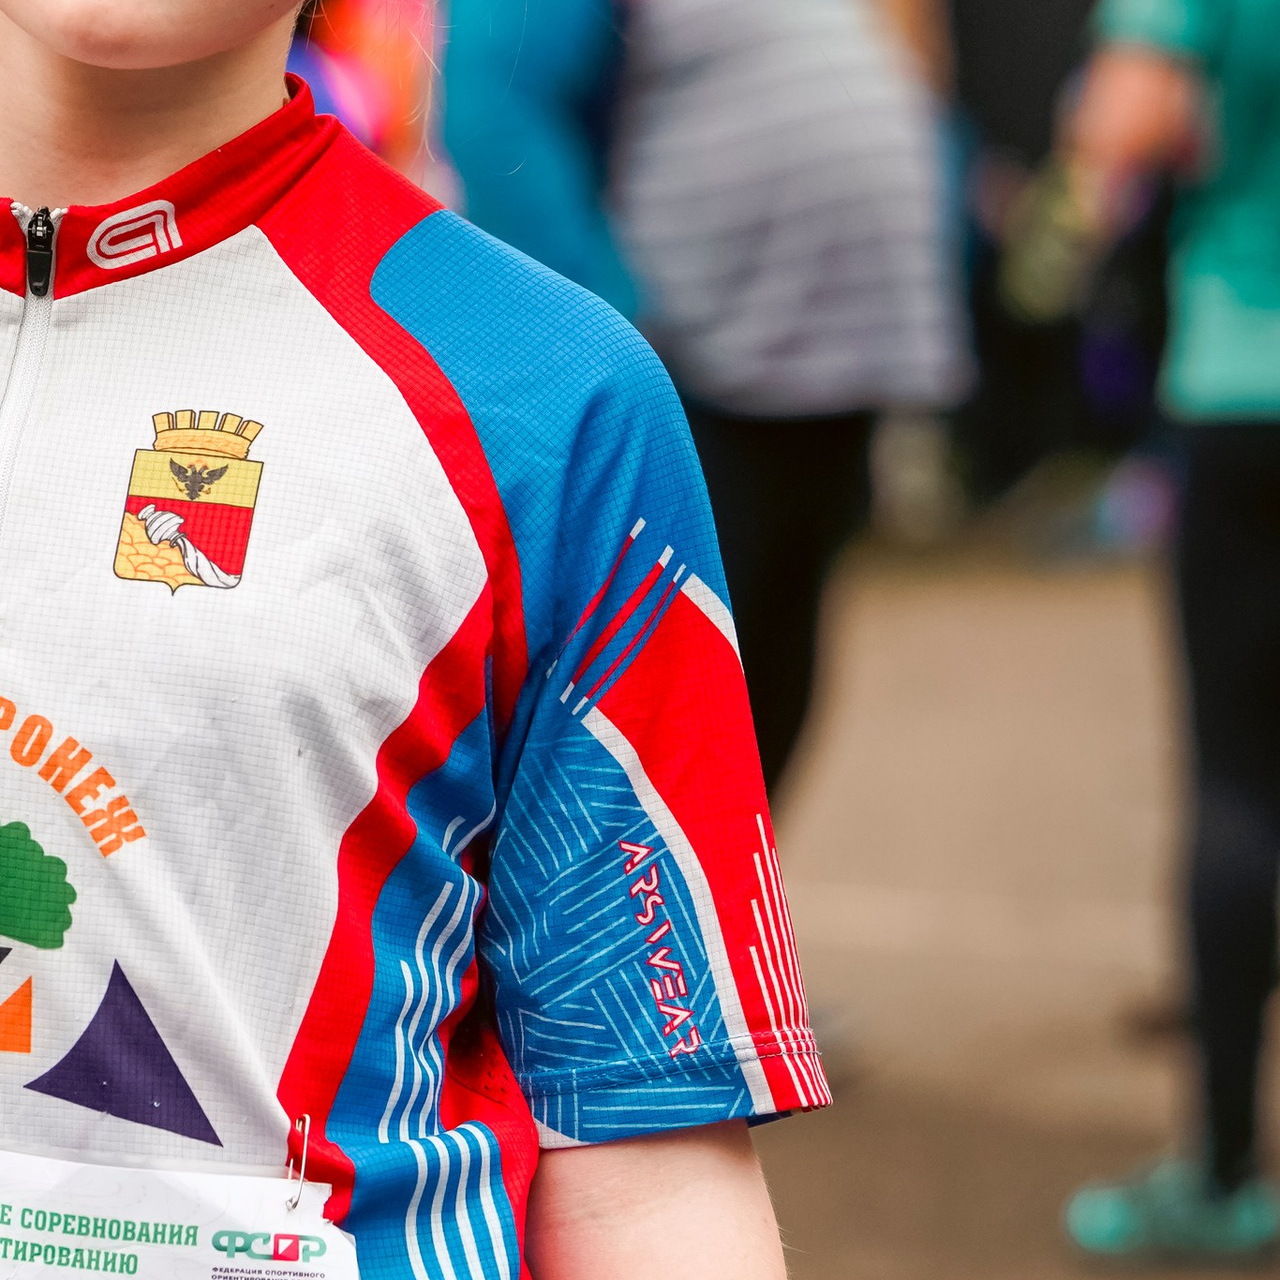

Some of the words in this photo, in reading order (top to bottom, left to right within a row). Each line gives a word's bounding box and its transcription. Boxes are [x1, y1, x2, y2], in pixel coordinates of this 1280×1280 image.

[618, 840, 701, 1058] ARSWEAR
[20, 1207, 199, 1246] СОРЕВНОВАНИЯ
[212, 1267, 263, 1275] ФЕДЕРАЦИЯ
[265, 1270, 326, 1278] СПОРТИВНОГО
